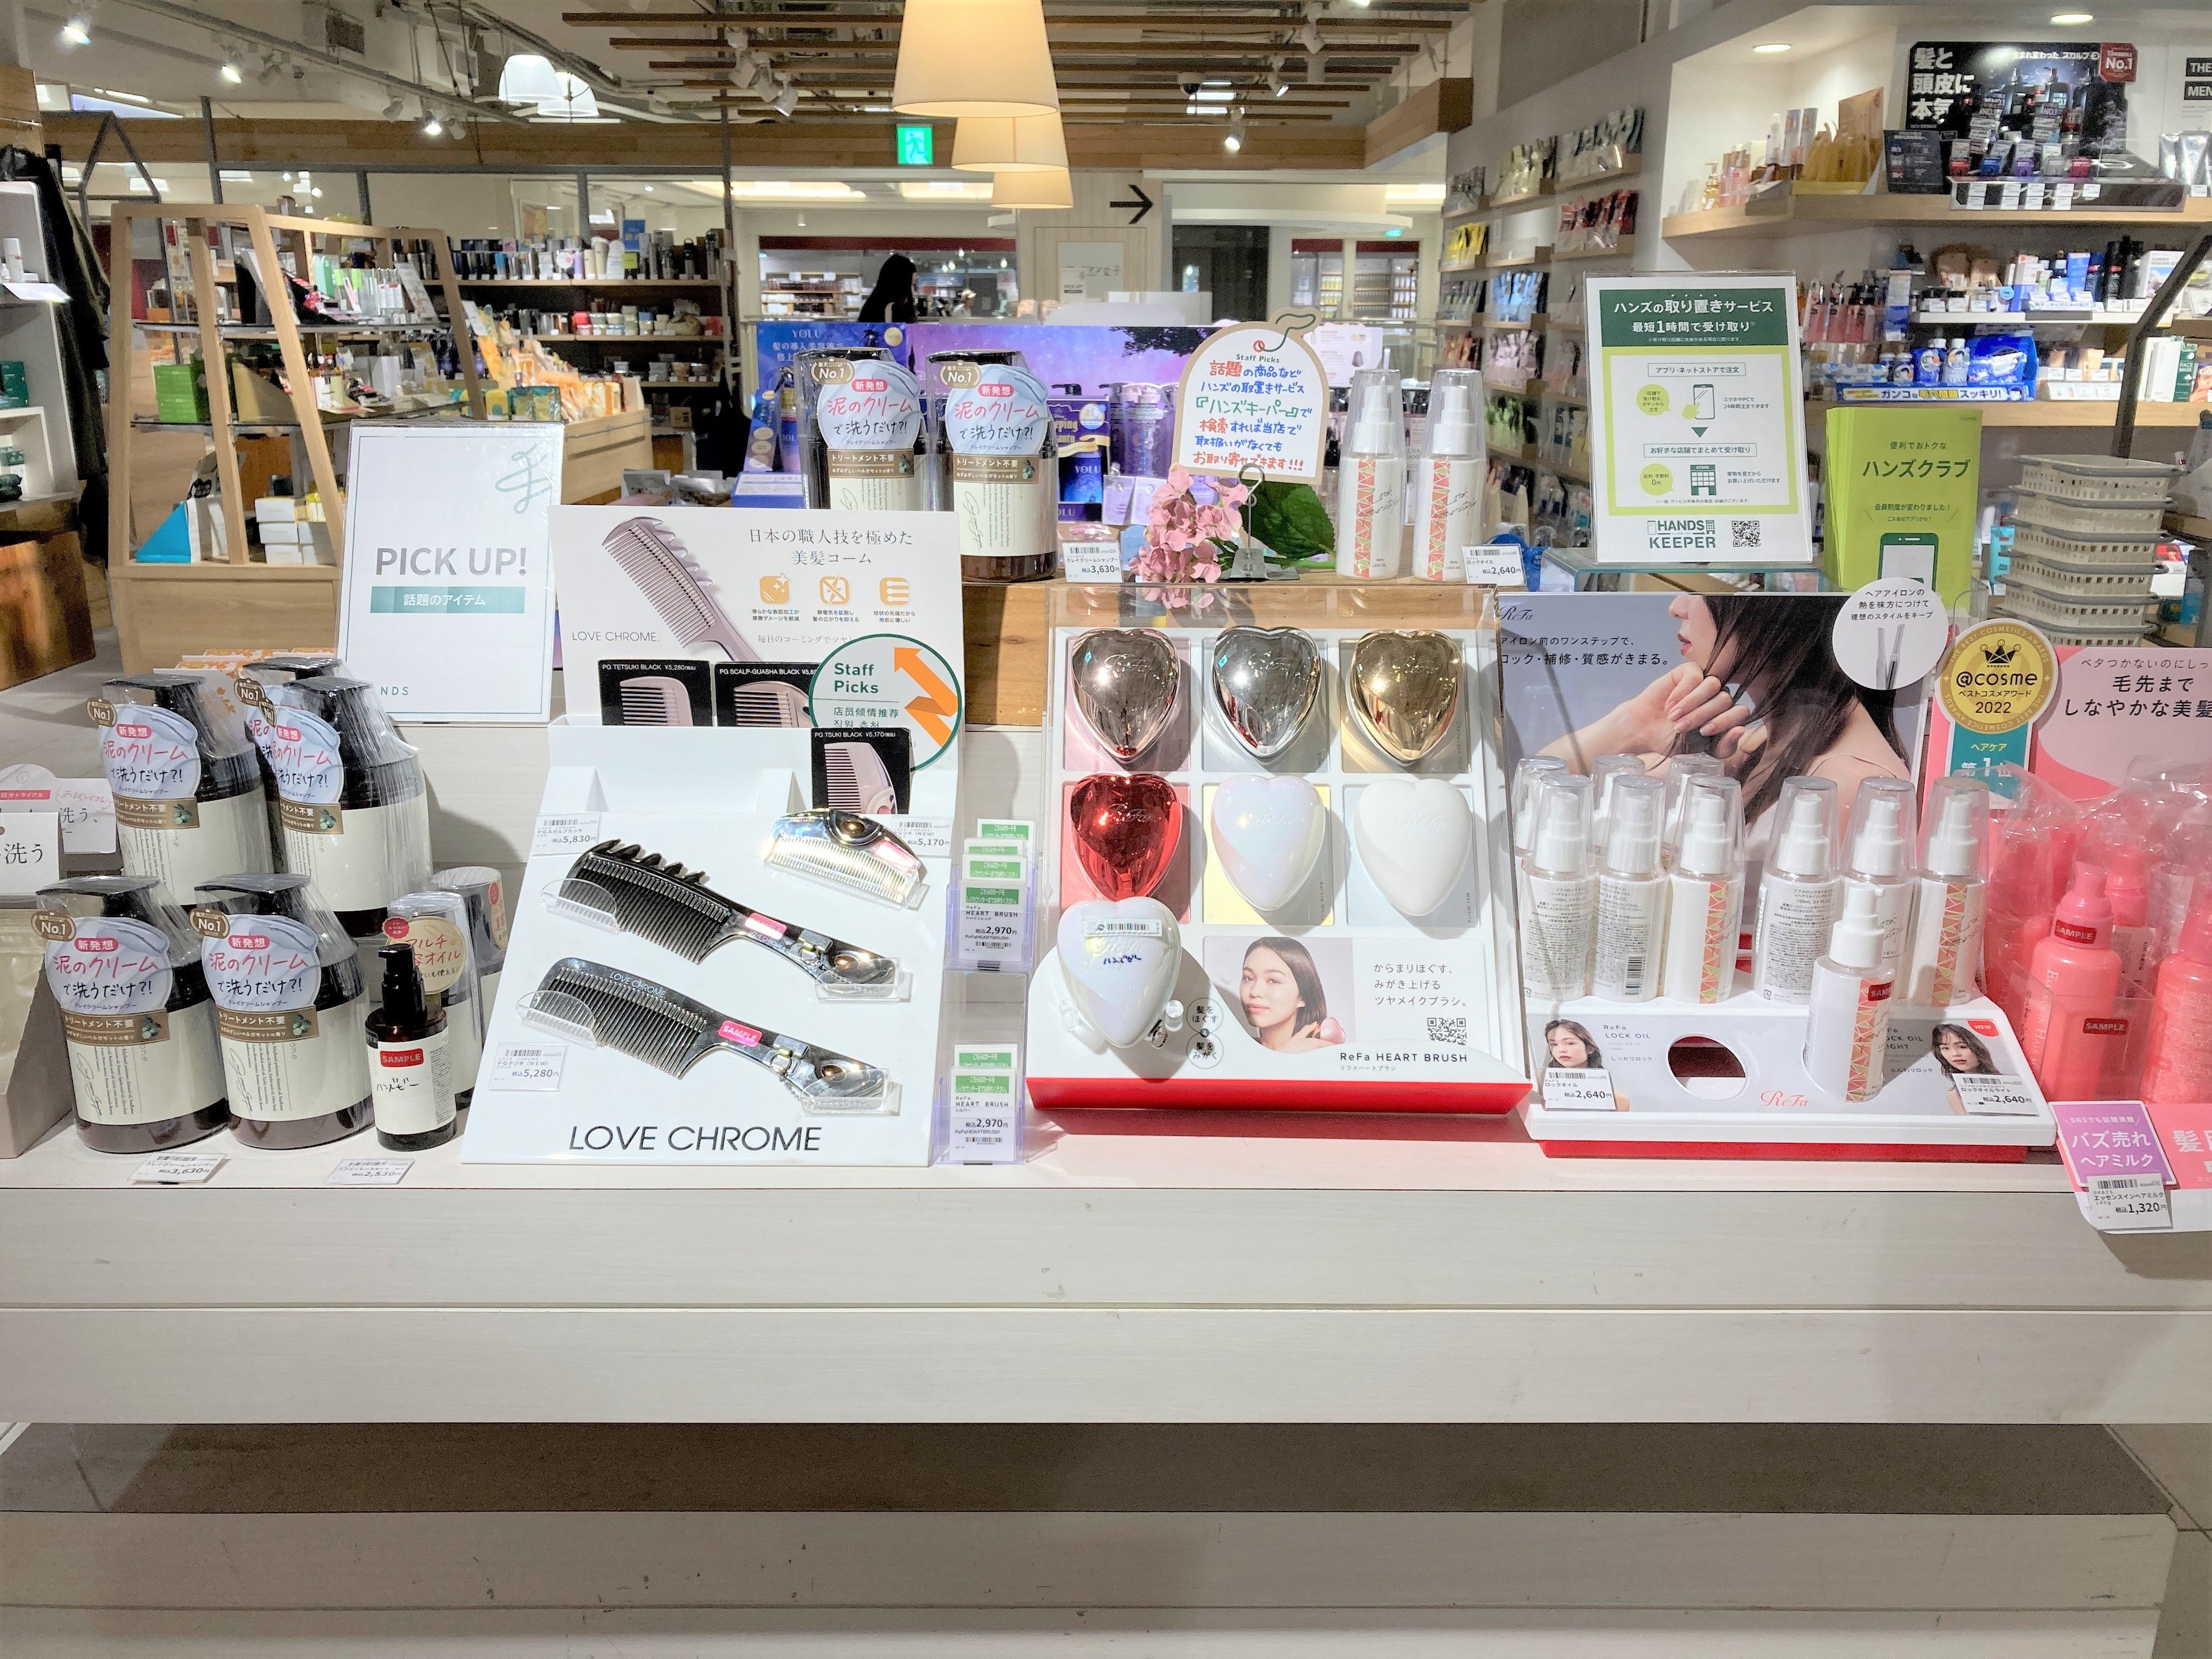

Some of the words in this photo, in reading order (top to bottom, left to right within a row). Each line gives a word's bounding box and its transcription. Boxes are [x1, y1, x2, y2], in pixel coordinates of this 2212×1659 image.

[1914, 48, 1953, 70] 髪と
[2105, 57, 2133, 70] No.1
[1913, 73, 1975, 95] 頭皮に
[1614, 299, 1774, 314] ハンズの取り置きサービス
[792, 328, 822, 339] YOLU
[819, 368, 845, 379] No.1
[1209, 360, 1302, 378] 話題の商品など
[947, 372, 973, 384] No.1
[855, 381, 885, 391] 新発想
[981, 385, 1011, 396] 新発想
[1201, 381, 1305, 394] ハンズの取置きサービス
[827, 396, 914, 417] 泥のクリーム
[954, 400, 1041, 420] 泥のクリーム
[834, 419, 907, 435] で洗うだけ?!
[959, 424, 1033, 441] で洗うだけ?!
[1200, 417, 1302, 435] 検索すれば当店で
[1194, 436, 1282, 451] 取扱いがなくても
[1890, 441, 1947, 450] 便利でおトクな
[831, 453, 895, 462] トリートメント不要
[956, 458, 1019, 468] トリートメント不要
[1074, 465, 1101, 474] YOLU
[1862, 458, 1972, 478] ハンズクラブ
[1657, 520, 1705, 532] HANDS
[749, 528, 913, 546] 日本の職人技を極めた
[1649, 537, 1716, 548] KEEPER
[375, 547, 458, 576] PICK
[468, 547, 527, 576] UP!
[791, 550, 872, 565] 美髪コーム
[1081, 564, 1120, 575] 税込3,630円
[1482, 566, 1522, 576] 税込2,640円
[403, 593, 486, 606] 話題のアイテム
[1865, 588, 1925, 598] ヘアアイロンの
[1859, 600, 1929, 610] 熱を味方につけて
[1498, 605, 1534, 621] ReFa
[1851, 611, 1934, 621] 理想のスタイルをキープ
[572, 631, 601, 641] LOVE
[1501, 635, 1635, 647] アイロン前のワンステップで、
[1980, 626, 2027, 637] COSMETICS
[2027, 634, 2049, 663] AWARDS
[834, 662, 875, 676] Staff
[1956, 671, 2038, 688] @cosme
[2112, 674, 2194, 693] 毛先まで
[380, 686, 410, 696] NDS
[834, 680, 879, 694] Picks
[241, 688, 259, 702] No.1
[834, 707, 900, 719] 店员倾情推荐
[1975, 701, 2012, 714] 2022
[93, 708, 111, 721] No.1
[118, 726, 148, 737] 新発想
[103, 740, 189, 765] 泥のクリーム
[1970, 742, 2007, 752] ヘアケア
[40, 921, 66, 936] No.1
[197, 919, 221, 934] No.1
[976, 926, 1017, 935] 税込2,970円
[2055, 925, 2093, 941] SAMPLE
[77, 939, 115, 951] 新発想
[230, 936, 267, 949] 新発想
[52, 955, 159, 980] 泥のクリーム
[209, 953, 309, 977] 泥のクリーム
[1373, 963, 1453, 974] からまりほぐす、
[62, 980, 153, 999] で洗うだけ?!
[217, 978, 303, 997] で洗うだけ?!
[1374, 979, 1441, 990] みがき上げる
[1374, 995, 1466, 1007] ツヤメイクブラシ。
[1196, 1006, 1214, 1014] 髪を
[64, 1014, 134, 1028] トリートメント不要
[218, 1012, 286, 1025] トリートメント不要
[2086, 1021, 2126, 1032] SAMPLE
[723, 1025, 758, 1042] SAMPLE
[1196, 1042, 1214, 1050] 髪を
[382, 1053, 421, 1063] SAMPLE
[1192, 1051, 1218, 1059] みがく
[1340, 1052, 1370, 1061] ReFa
[1376, 1053, 1418, 1062] HEART
[1424, 1053, 1468, 1062] BRUSH
[1564, 1090, 1612, 1099] 税込2,640円
[1760, 1090, 1809, 1107] ReFa
[965, 1118, 1008, 1128] 税込2,970円
[569, 1125, 658, 1151] LOVE
[667, 1125, 823, 1151] CHROME
[2071, 1130, 2151, 1149] バズ売れ
[2080, 1154, 2154, 1168] ヘアミルク
[2093, 1192, 2164, 1201] エッセンスインヘアミルク
[2115, 1202, 2168, 1215] 税込1,320円
